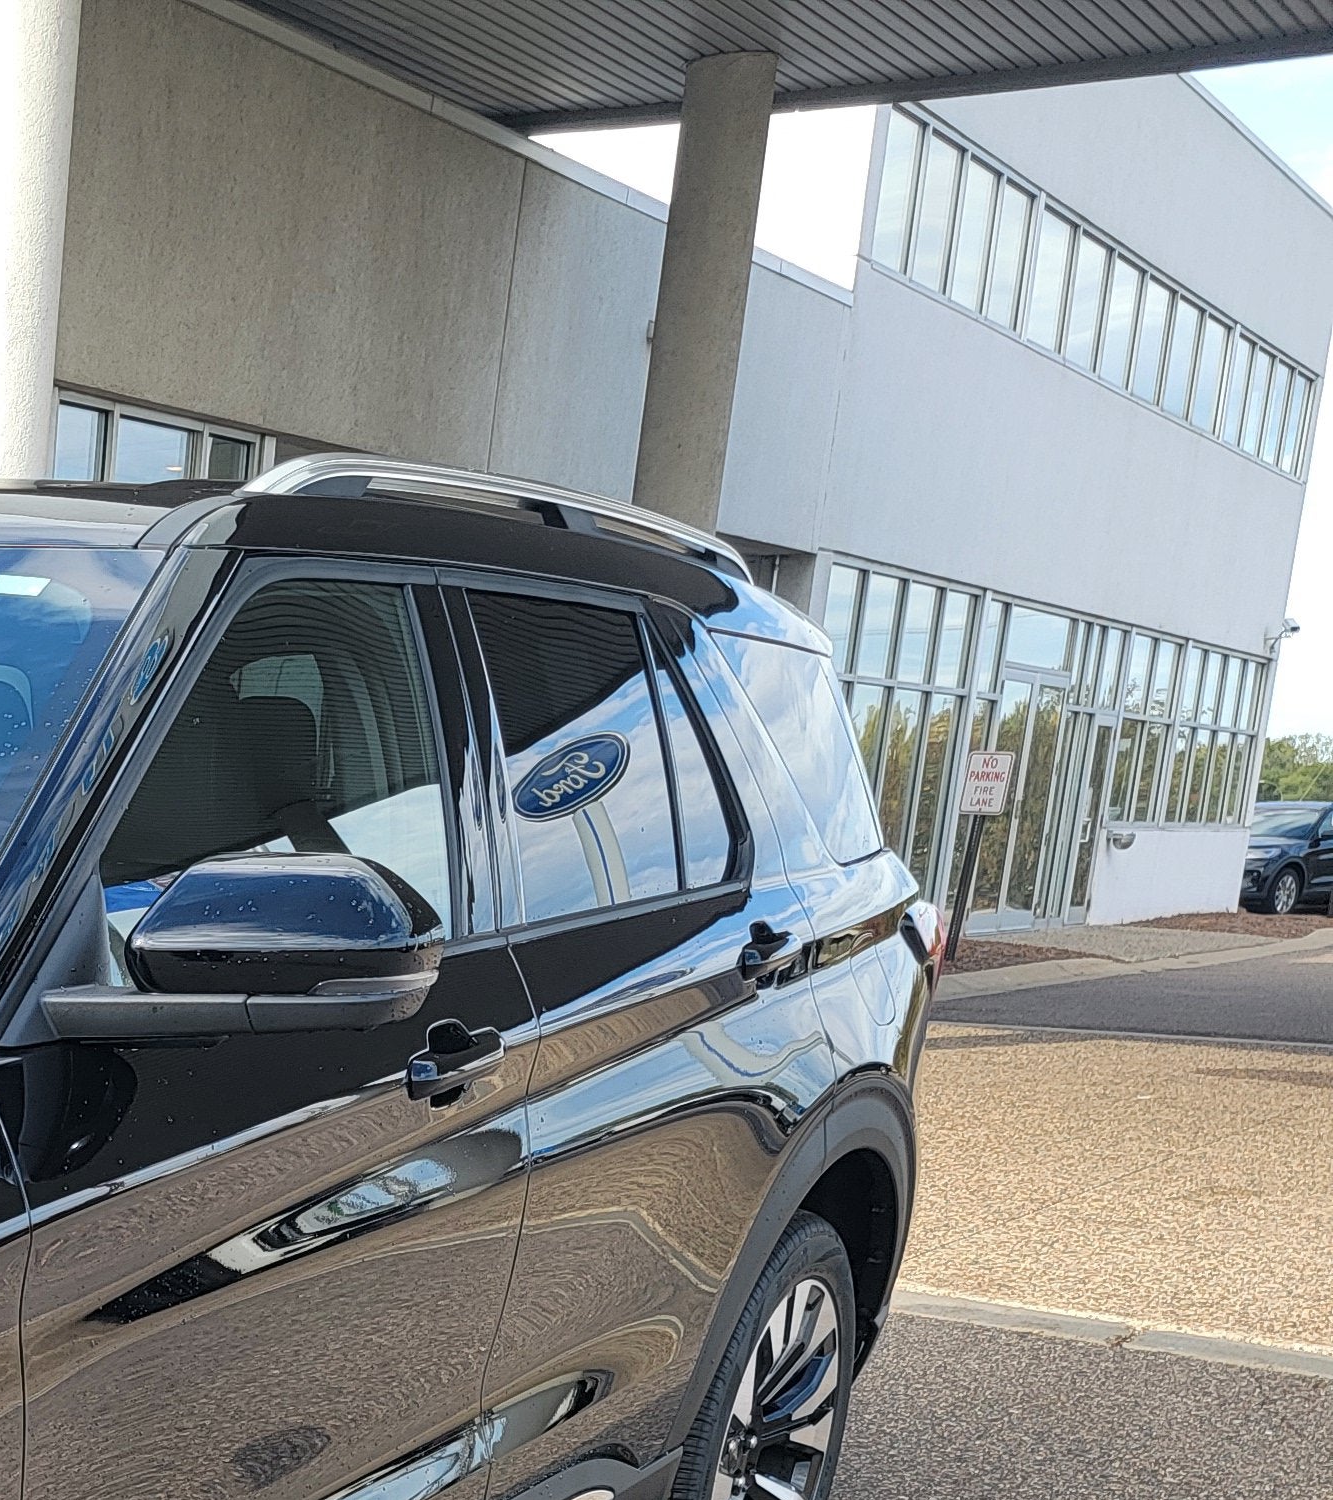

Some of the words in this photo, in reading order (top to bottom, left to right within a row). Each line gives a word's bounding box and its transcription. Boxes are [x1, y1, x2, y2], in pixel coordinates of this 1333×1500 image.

[982, 757, 999, 769] NO
[969, 771, 1006, 782] PARKING
[974, 786, 996, 796] FIRE
[970, 798, 995, 807] LANE
